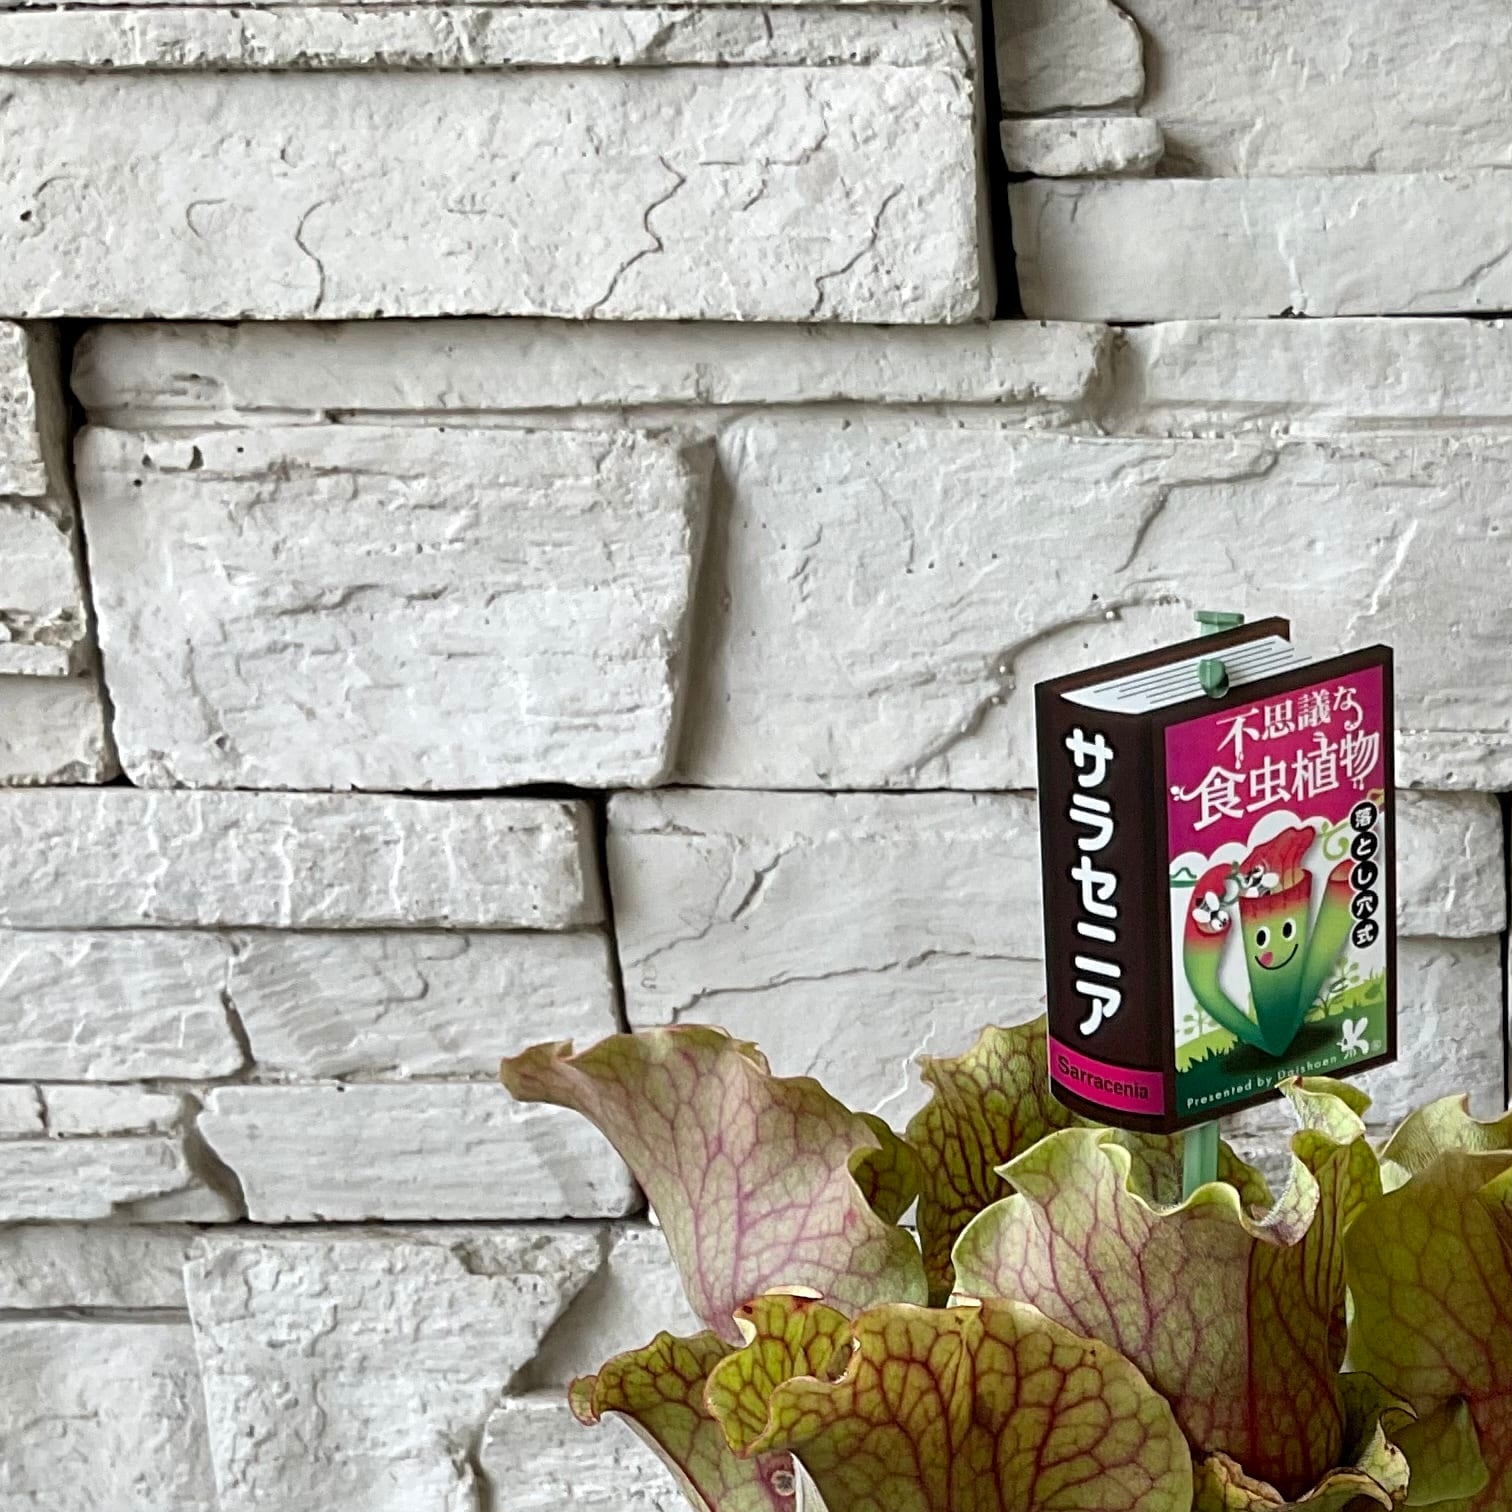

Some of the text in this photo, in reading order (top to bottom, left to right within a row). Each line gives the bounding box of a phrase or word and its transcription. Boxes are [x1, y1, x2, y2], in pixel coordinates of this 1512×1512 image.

[1215, 685, 1364, 770] 不思議な
[1169, 731, 1380, 832] 食虫植物
[1065, 728, 1122, 1037] サラセニア
[1353, 806, 1375, 946] 落とし穴式
[1056, 1054, 1149, 1100] Sarracenia
[1186, 1082, 1252, 1110] Presented
[1256, 1074, 1273, 1092] by
